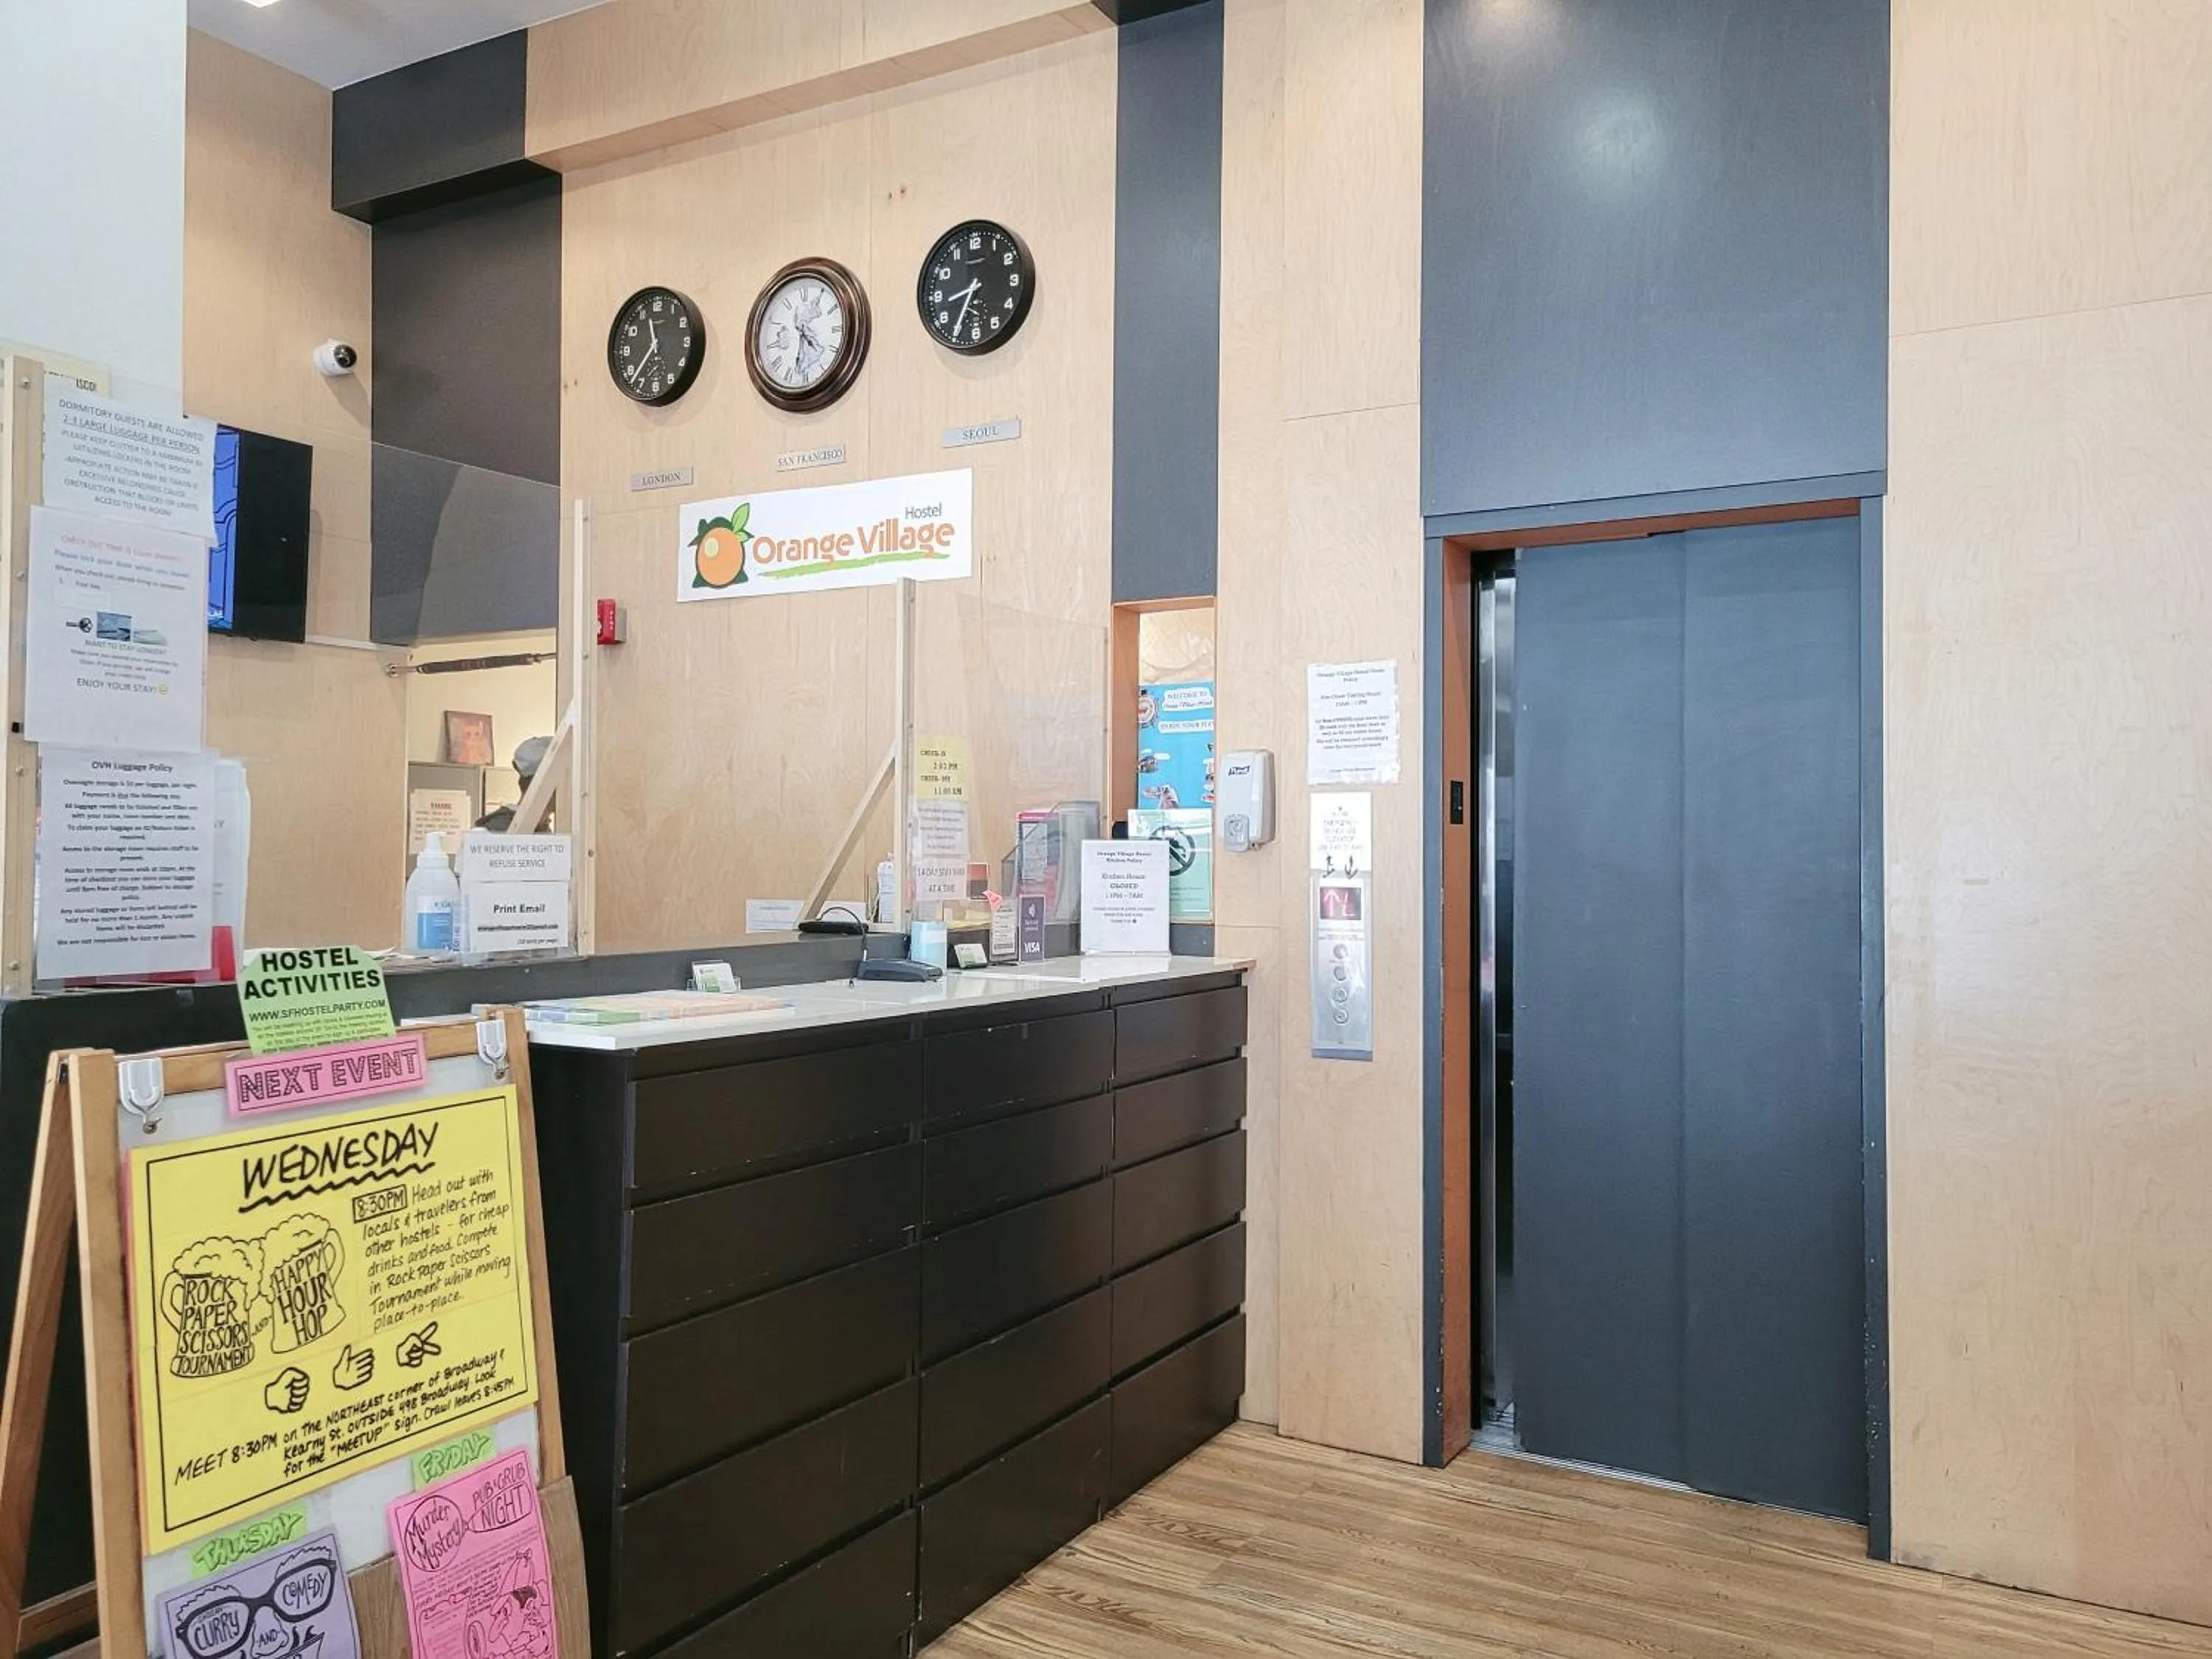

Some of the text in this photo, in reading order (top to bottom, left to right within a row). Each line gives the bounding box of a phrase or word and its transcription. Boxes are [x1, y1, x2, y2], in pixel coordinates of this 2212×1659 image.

[970, 237, 981, 249] 12
[1004, 253, 1013, 265] 2
[1009, 274, 1019, 286] 3
[933, 291, 943, 302] 9
[1004, 298, 1013, 310] 4
[59, 399, 111, 418] DORMITORY
[115, 414, 145, 426] GUESTS
[111, 423, 147, 439] LUGGAGE
[962, 425, 998, 440] SEOUL
[778, 448, 843, 467] SAN FRANCISCO
[642, 472, 681, 485] LONDON
[905, 502, 942, 519] Hostel
[752, 517, 956, 566] Orange Village
[77, 678, 104, 688] ENJOY
[107, 682, 131, 691] YOUR
[91, 761, 173, 773] OVH Luggage Policy
[516, 845, 529, 853] THE
[531, 844, 553, 853] RIGHT
[554, 844, 564, 852] TO
[518, 858, 546, 868] SERVICE
[493, 903, 546, 914] Print Email
[261, 947, 358, 973] HOSTEL
[1024, 942, 1040, 954] VISA
[243, 970, 380, 1000] ACTIVITIES
[248, 999, 386, 1022] WWW.SFHOSTELPARTY.COM
[240, 1048, 417, 1103] NEXT EVENT
[243, 1121, 439, 1199] WEDNESDAY
[355, 1169, 493, 1217] 8:30PM Head out with
[363, 1217, 400, 1240] locals
[414, 1198, 466, 1222] travelers
[468, 1190, 496, 1208] from
[366, 1203, 509, 1257] other hostels for cheap
[368, 1257, 403, 1278] drinks
[456, 1226, 499, 1248] Compete
[275, 1249, 323, 1291] HAPPY
[369, 1244, 491, 1295] in Rock Paper Scissors
[369, 1255, 511, 1315] Tournament while moving
[185, 1279, 234, 1306] ROCK
[279, 1272, 332, 1324] HOUR
[184, 1301, 237, 1330] PAPER
[293, 1305, 328, 1346] HOP
[180, 1321, 249, 1354] SCISSORS
[176, 1346, 252, 1375] TOURNAMENT
[283, 1429, 298, 1444] on
[301, 1421, 322, 1434] the
[326, 1394, 384, 1428] NORTHEAST
[387, 1382, 425, 1403] corner
[428, 1371, 440, 1386] of
[444, 1349, 498, 1380] Broadway
[284, 1436, 325, 1461] Kearny
[347, 1408, 395, 1434] OUTSIDE
[475, 1368, 497, 1384] Look
[283, 1459, 302, 1478] for
[307, 1453, 325, 1467] the
[424, 1401, 451, 1419] Crawl
[453, 1389, 481, 1409] leaves
[175, 1433, 278, 1486] MEET 8:30PM
[418, 1433, 492, 1484] FRIDAY
[498, 1462, 526, 1492] GRUB
[481, 1486, 526, 1530] NIGHT
[408, 1497, 451, 1553] Murder
[192, 1512, 304, 1572] THURSDAY
[416, 1518, 465, 1571] Mystery
[282, 1571, 328, 1610] COMEDY
[194, 1609, 240, 1650] CURRY
